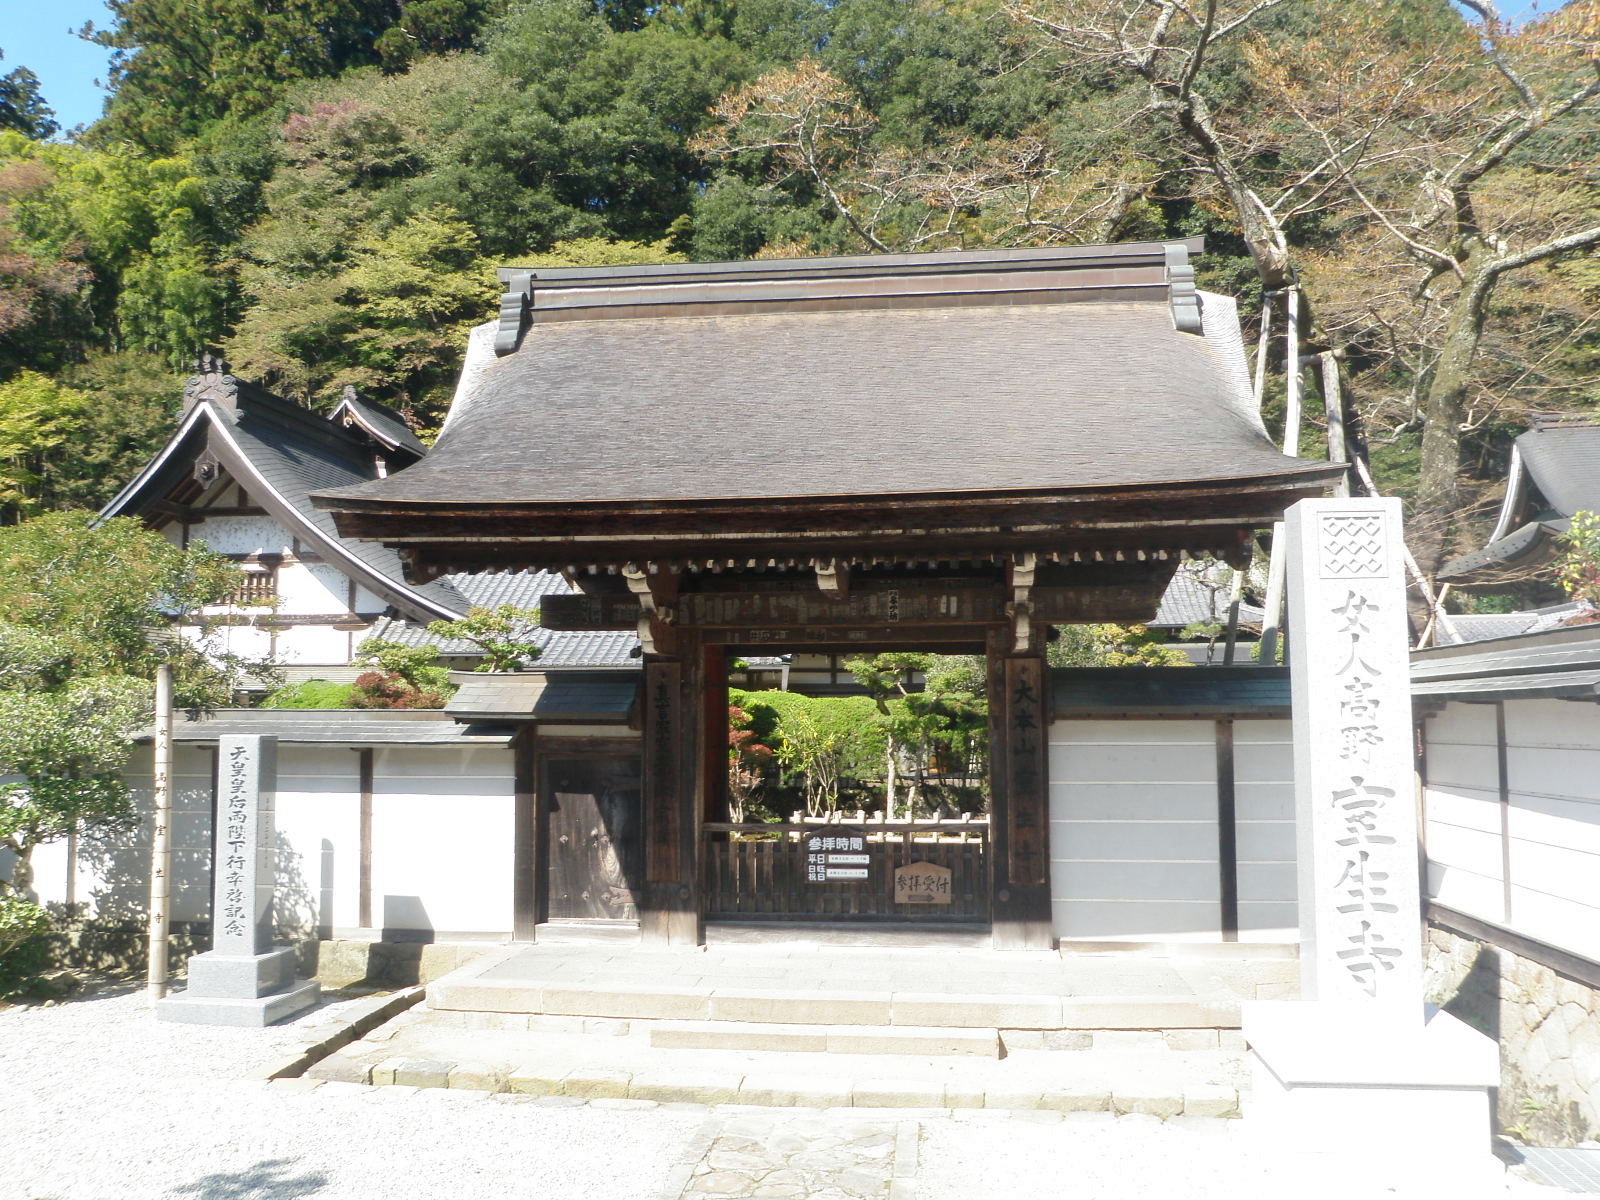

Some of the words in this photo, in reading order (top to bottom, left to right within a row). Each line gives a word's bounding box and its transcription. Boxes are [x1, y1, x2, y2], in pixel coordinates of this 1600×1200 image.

[1331, 588, 1403, 998] 女人高野室生寺
[808, 837, 863, 851] 参拝時間
[808, 853, 825, 864] 平日
